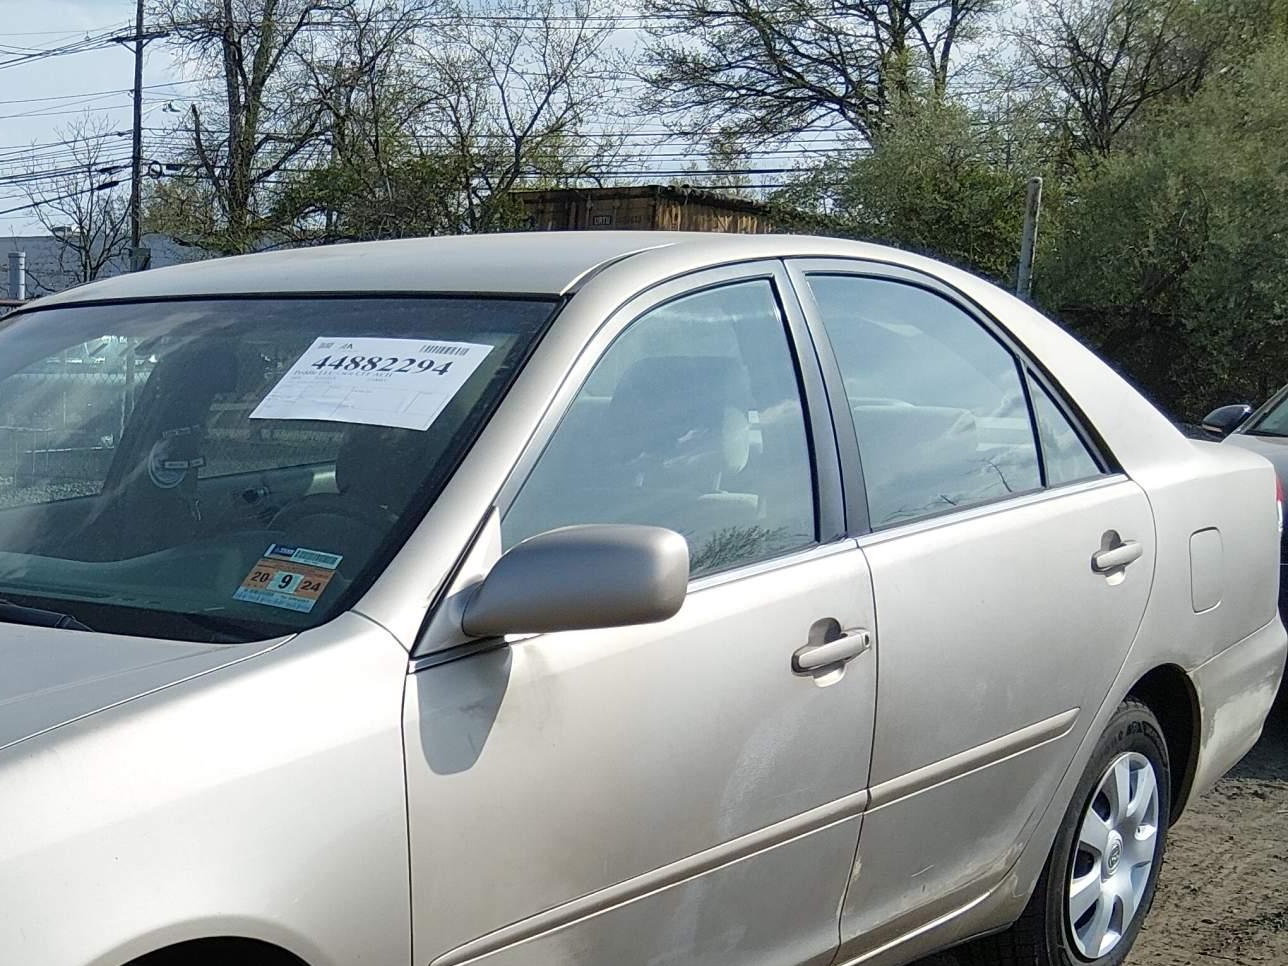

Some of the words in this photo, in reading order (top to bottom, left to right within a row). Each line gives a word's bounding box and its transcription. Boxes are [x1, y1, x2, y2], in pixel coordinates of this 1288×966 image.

[312, 355, 454, 376] 44882294
[251, 571, 269, 582] 20
[278, 574, 293, 589] 9
[300, 580, 321, 592] 24
